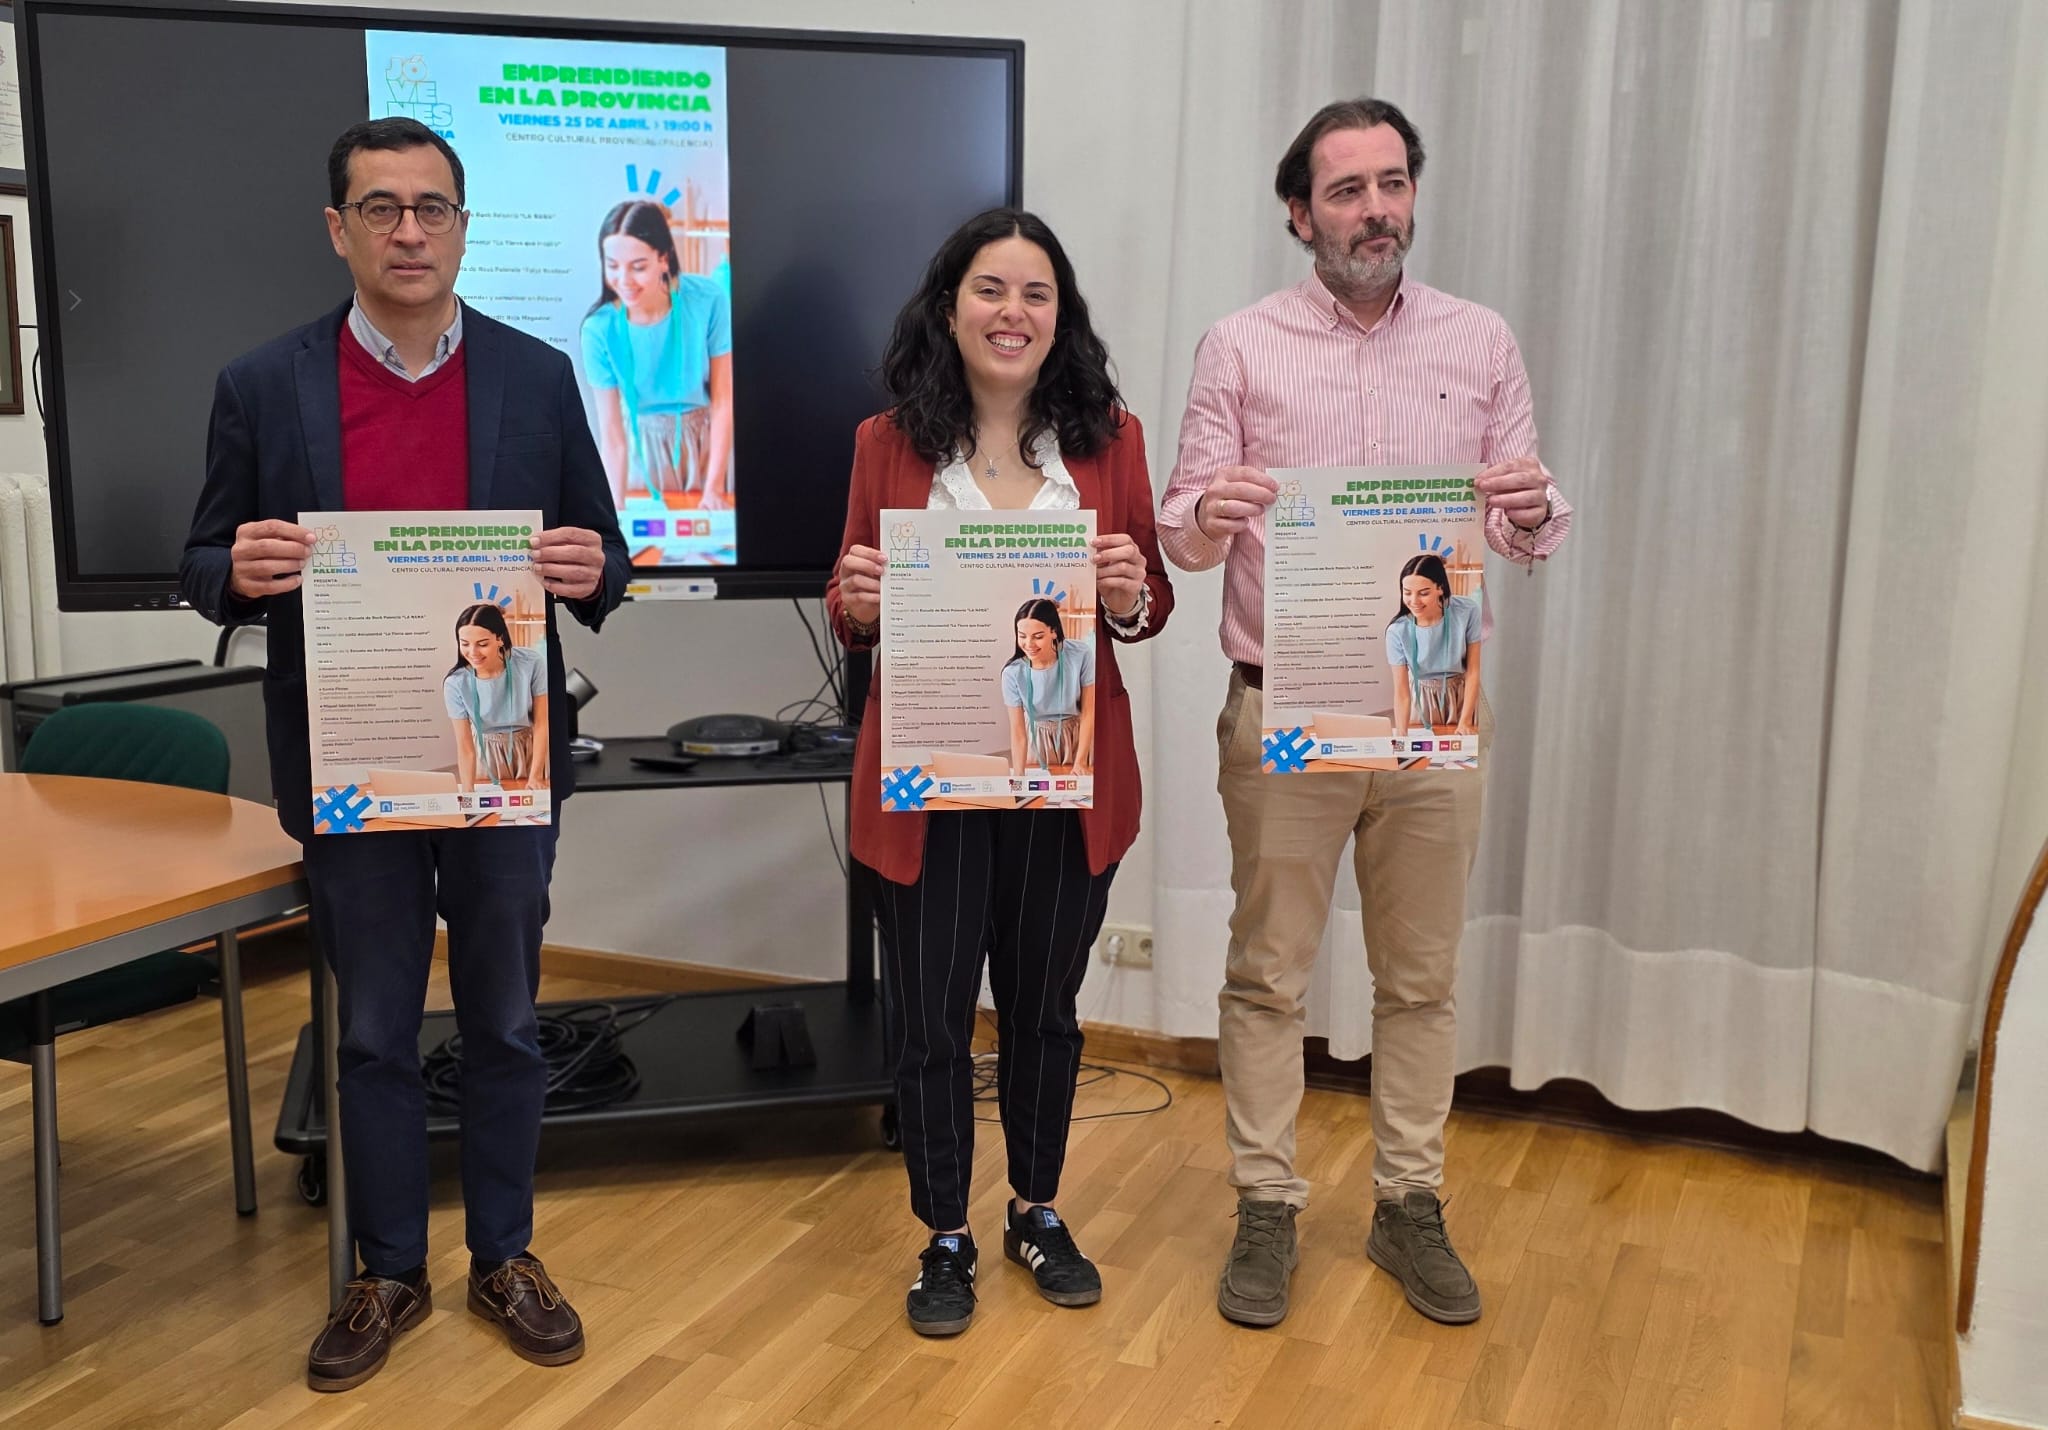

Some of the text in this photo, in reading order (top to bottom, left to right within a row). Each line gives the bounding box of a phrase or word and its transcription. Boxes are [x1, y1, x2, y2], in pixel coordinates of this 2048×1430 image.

[502, 64, 711, 89] EMPRENDIENDO
[479, 86, 711, 112] EN LA PROVINCIA
[498, 113, 712, 132] VIERNES 25 DE ABRIL 19:00 h
[505, 132, 545, 142] CENTRO
[547, 134, 598, 144] CULTURAL
[1346, 478, 1475, 491] EMPRENDIENDO
[1331, 491, 1476, 505] EN LA PROVINCIA
[1342, 505, 1476, 517] VIERNES 25 DE ABRIL 19:00 h
[390, 525, 532, 537] EMPRENDIENDO
[959, 523, 1087, 535] EMPRENDIENDO
[373, 539, 533, 551] EN LA PROVINCIA
[945, 537, 1087, 548] EN LA PROVINCIA
[387, 555, 431, 563] VIERNES
[431, 555, 444, 563] 25
[446, 555, 459, 563] DE
[499, 554, 525, 562] 19:00
[956, 552, 994, 560] VIERNES
[1056, 551, 1080, 559] 19:00
[1082, 551, 1088, 559] h
